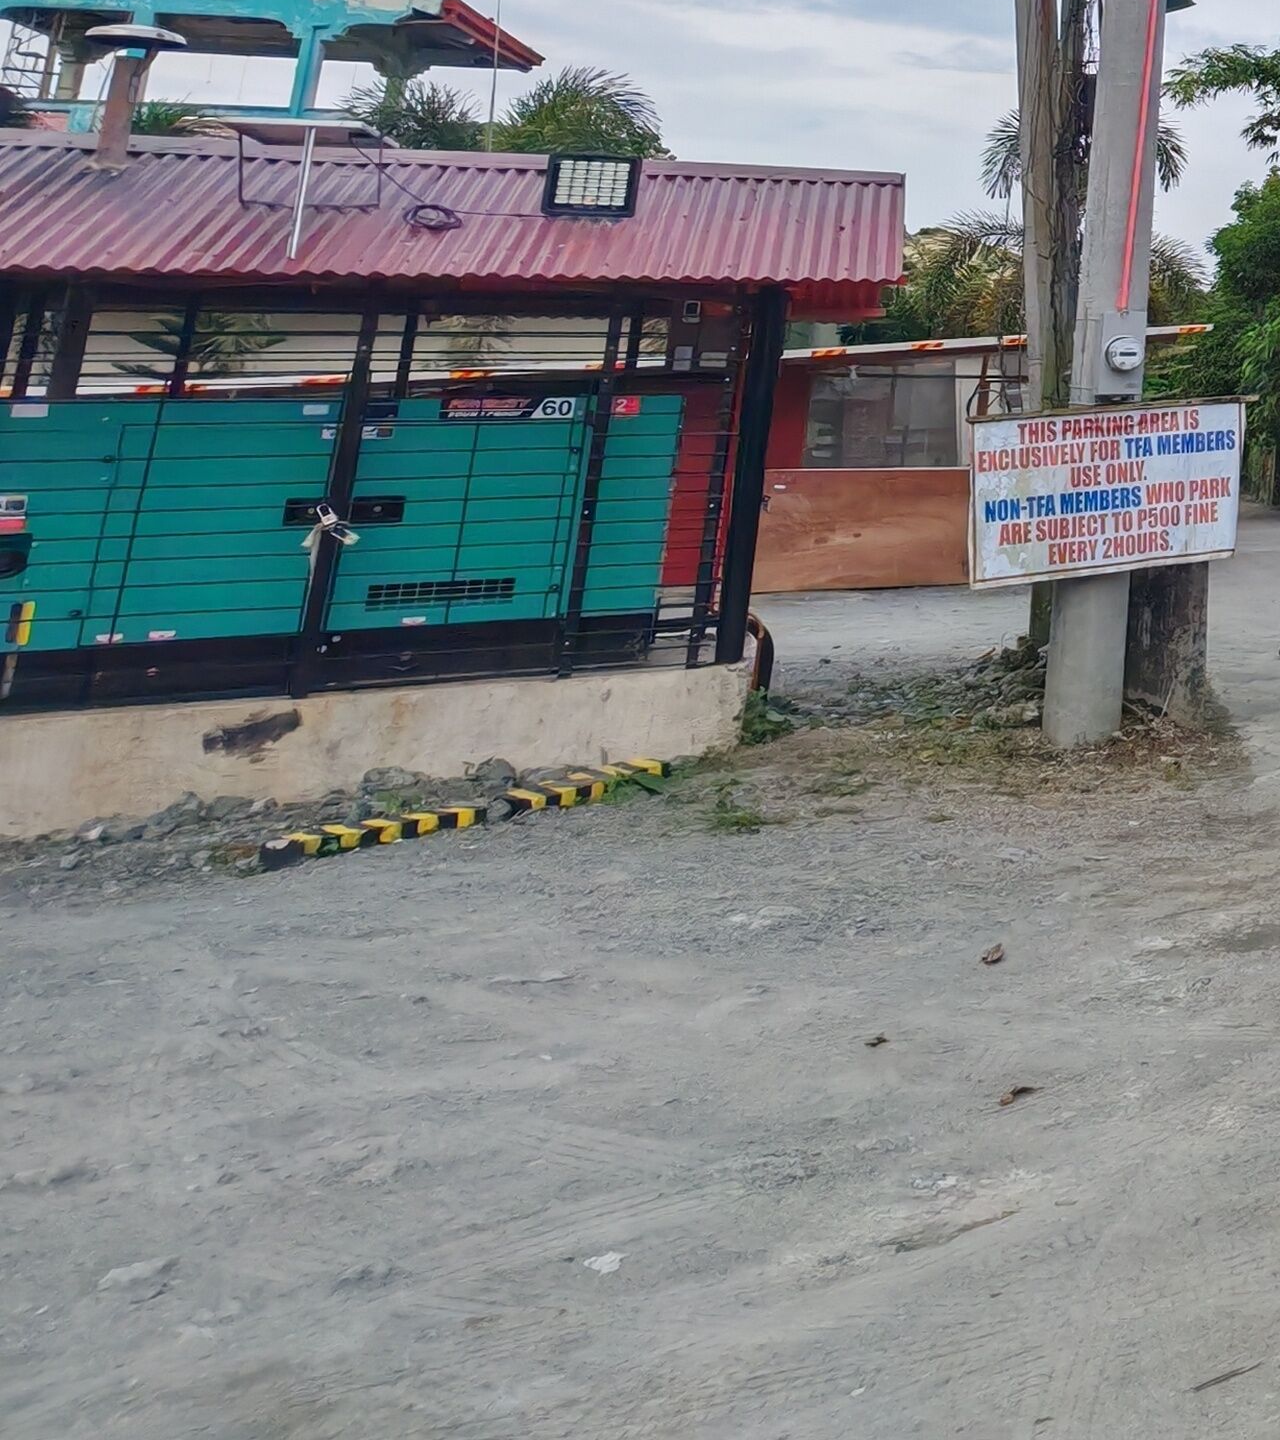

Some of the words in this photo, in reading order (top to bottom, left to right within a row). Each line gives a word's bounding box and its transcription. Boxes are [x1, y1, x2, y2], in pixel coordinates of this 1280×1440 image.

[540, 398, 574, 417] 60
[1017, 420, 1057, 444] THIS
[1061, 414, 1135, 440] PARKING
[1138, 411, 1180, 434] AREA
[1183, 408, 1200, 431] IS
[978, 442, 1087, 473] EXCLUSIVELY
[1090, 438, 1121, 463] FOR
[1124, 435, 1153, 459] TFA
[1156, 429, 1236, 456] MEMBERS
[1070, 463, 1101, 488] USE
[1105, 460, 1148, 485] ONLY.
[984, 493, 1056, 523] NON-TFA
[1060, 485, 1142, 515] MEMBERS
[1145, 480, 1186, 504] WHO
[1189, 477, 1232, 501] PARK
[999, 521, 1032, 547] ARE
[1036, 513, 1109, 542] SUBJECT
[1112, 511, 1133, 532] TO
[1137, 506, 1181, 530] P500
[1184, 501, 1219, 525] FINE
[1048, 540, 1098, 566] EVERY
[1101, 530, 1174, 560] 2HOURS.
